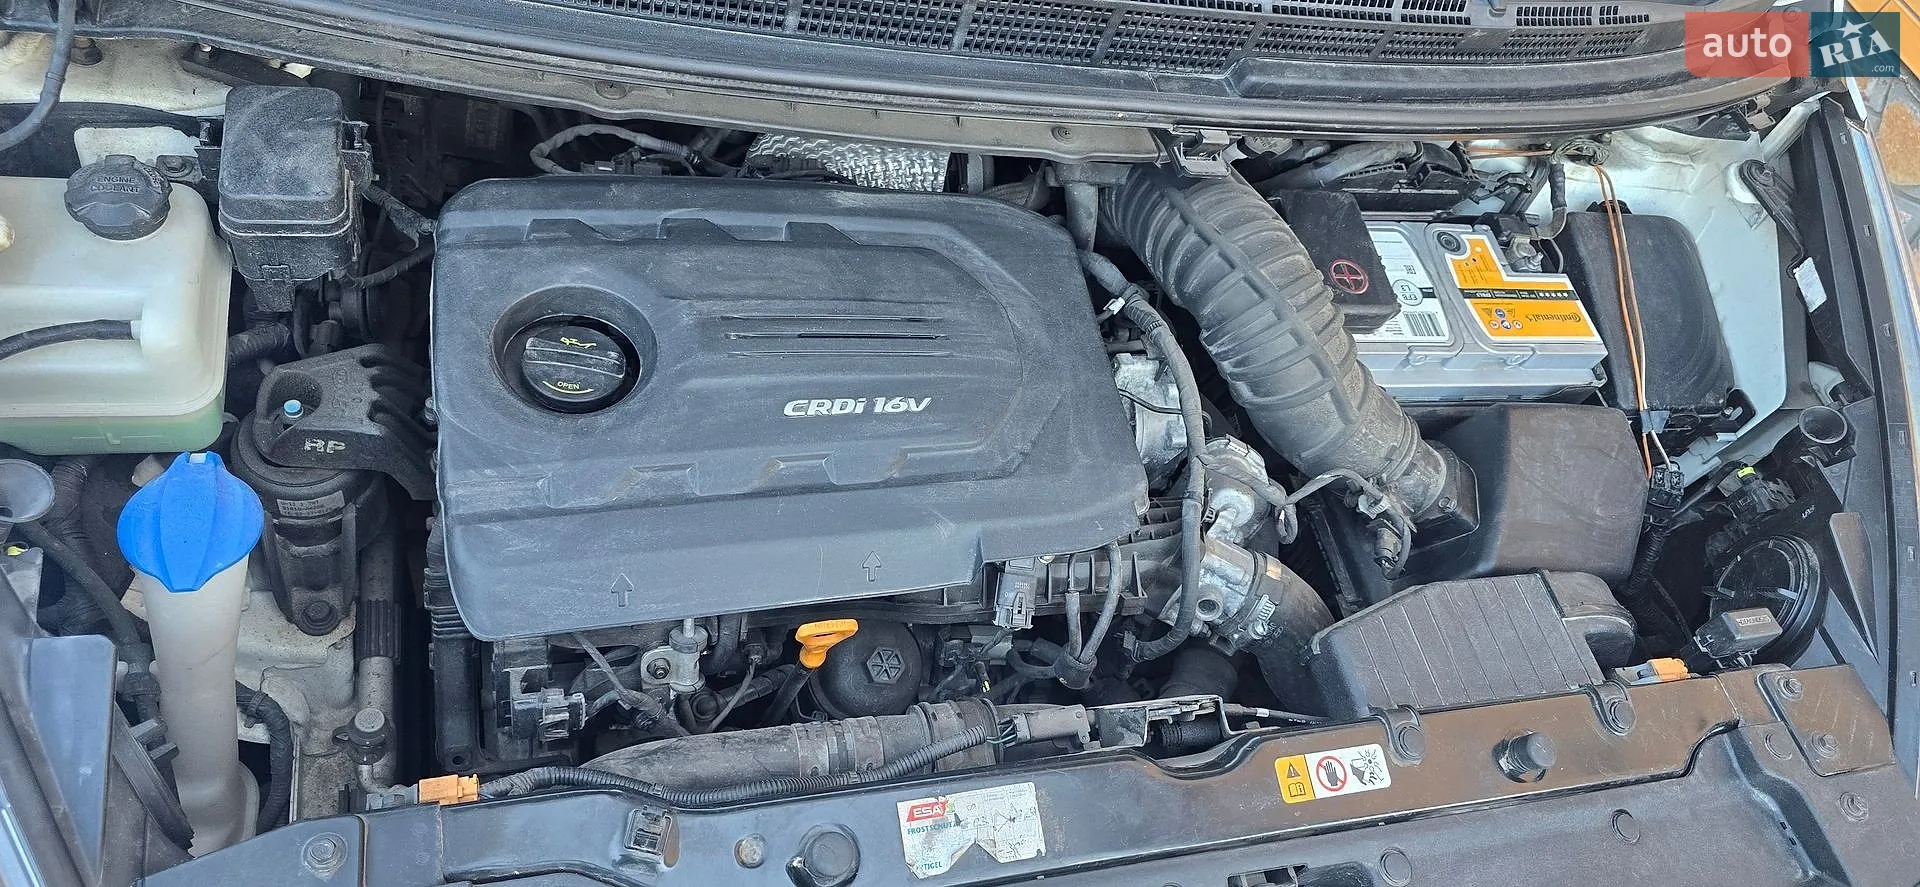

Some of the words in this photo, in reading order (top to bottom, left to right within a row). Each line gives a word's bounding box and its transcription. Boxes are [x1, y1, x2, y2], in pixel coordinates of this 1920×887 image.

[97, 175, 136, 184] ENGINE
[90, 183, 141, 194] COOLANT
[1401, 293, 1418, 301] EFB
[1532, 311, 1581, 323] Continental
[557, 380, 580, 390] OPEN
[783, 397, 868, 416] CRDi
[873, 396, 933, 413] 16V
[303, 437, 346, 454] RP
[913, 805, 942, 817] ESA
